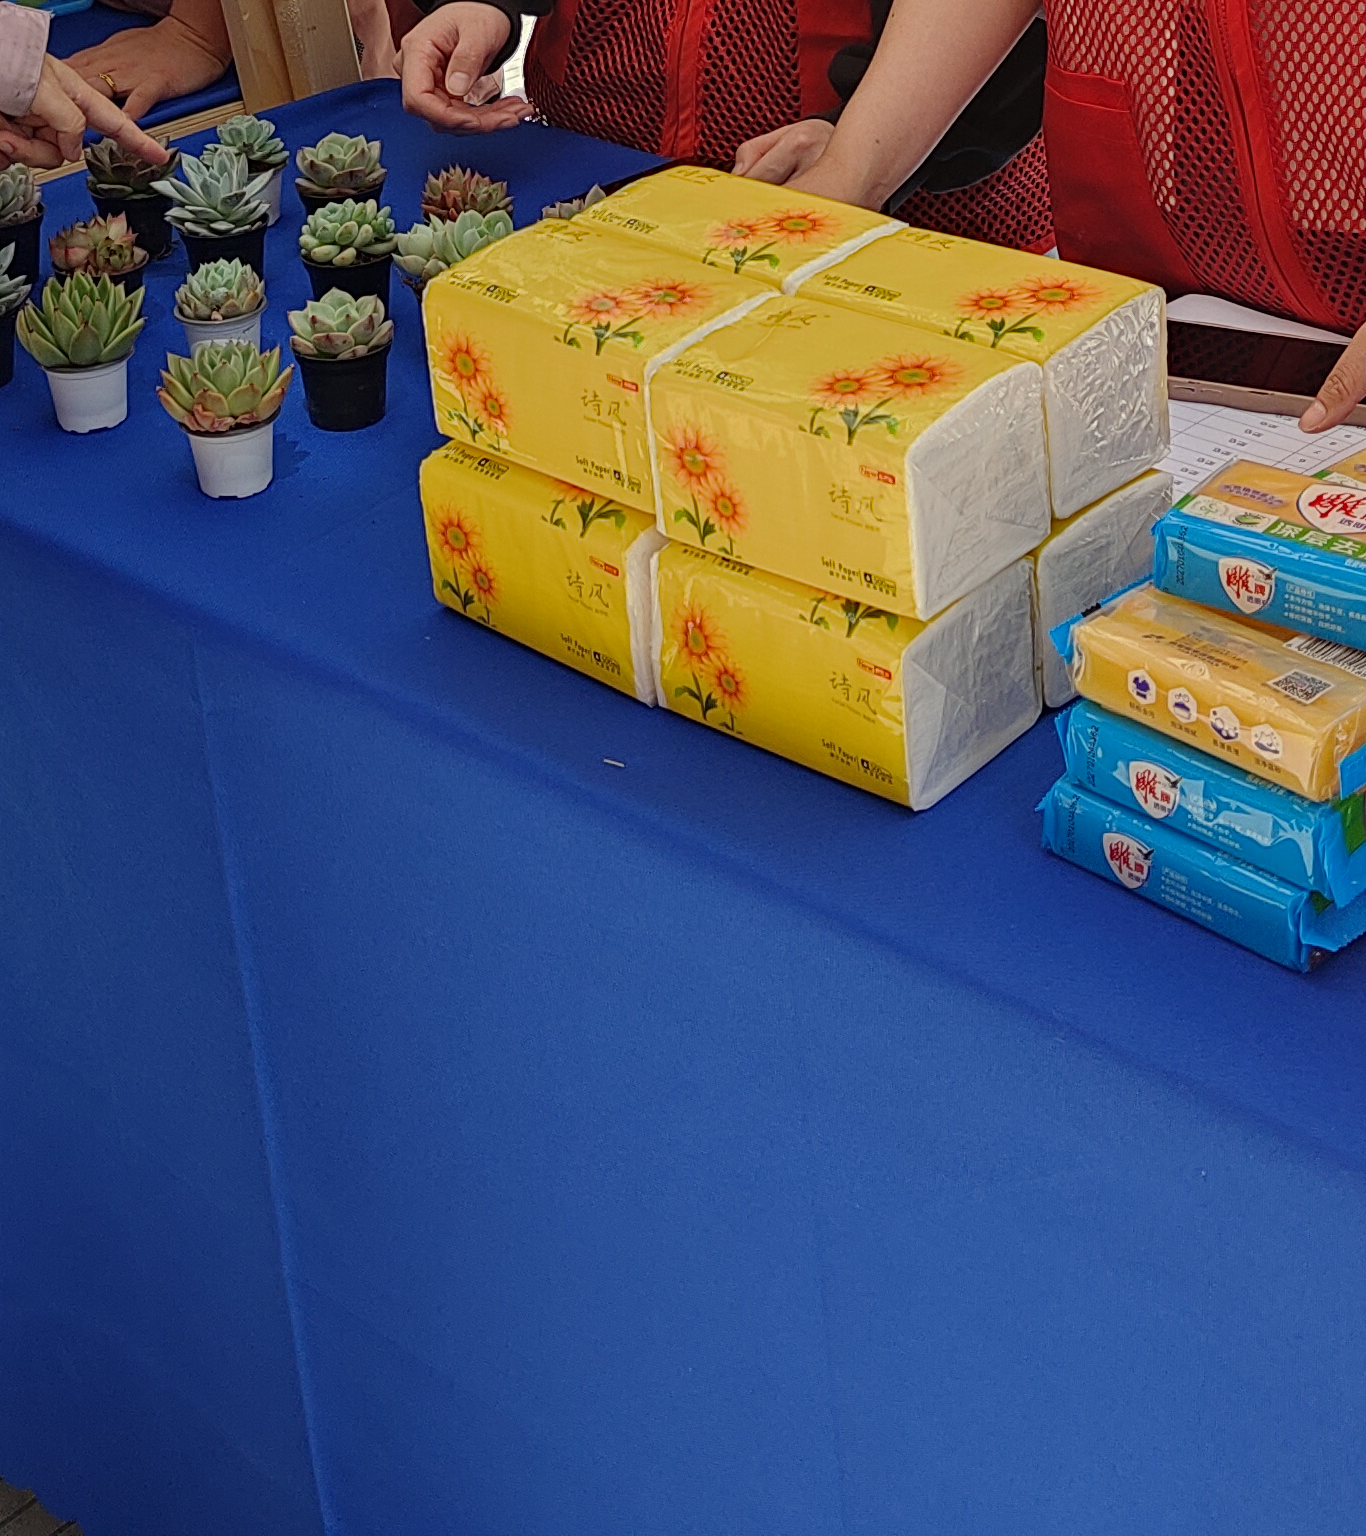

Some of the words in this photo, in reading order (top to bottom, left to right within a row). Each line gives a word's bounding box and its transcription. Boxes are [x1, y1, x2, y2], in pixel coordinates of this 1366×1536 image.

[828, 482, 884, 524] 诗风
[565, 568, 611, 610] 诗风
[1225, 563, 1267, 599] 雕牌
[828, 670, 878, 716] 诗风
[1134, 768, 1172, 805] 雕牌
[1109, 840, 1145, 877] 雕牌
